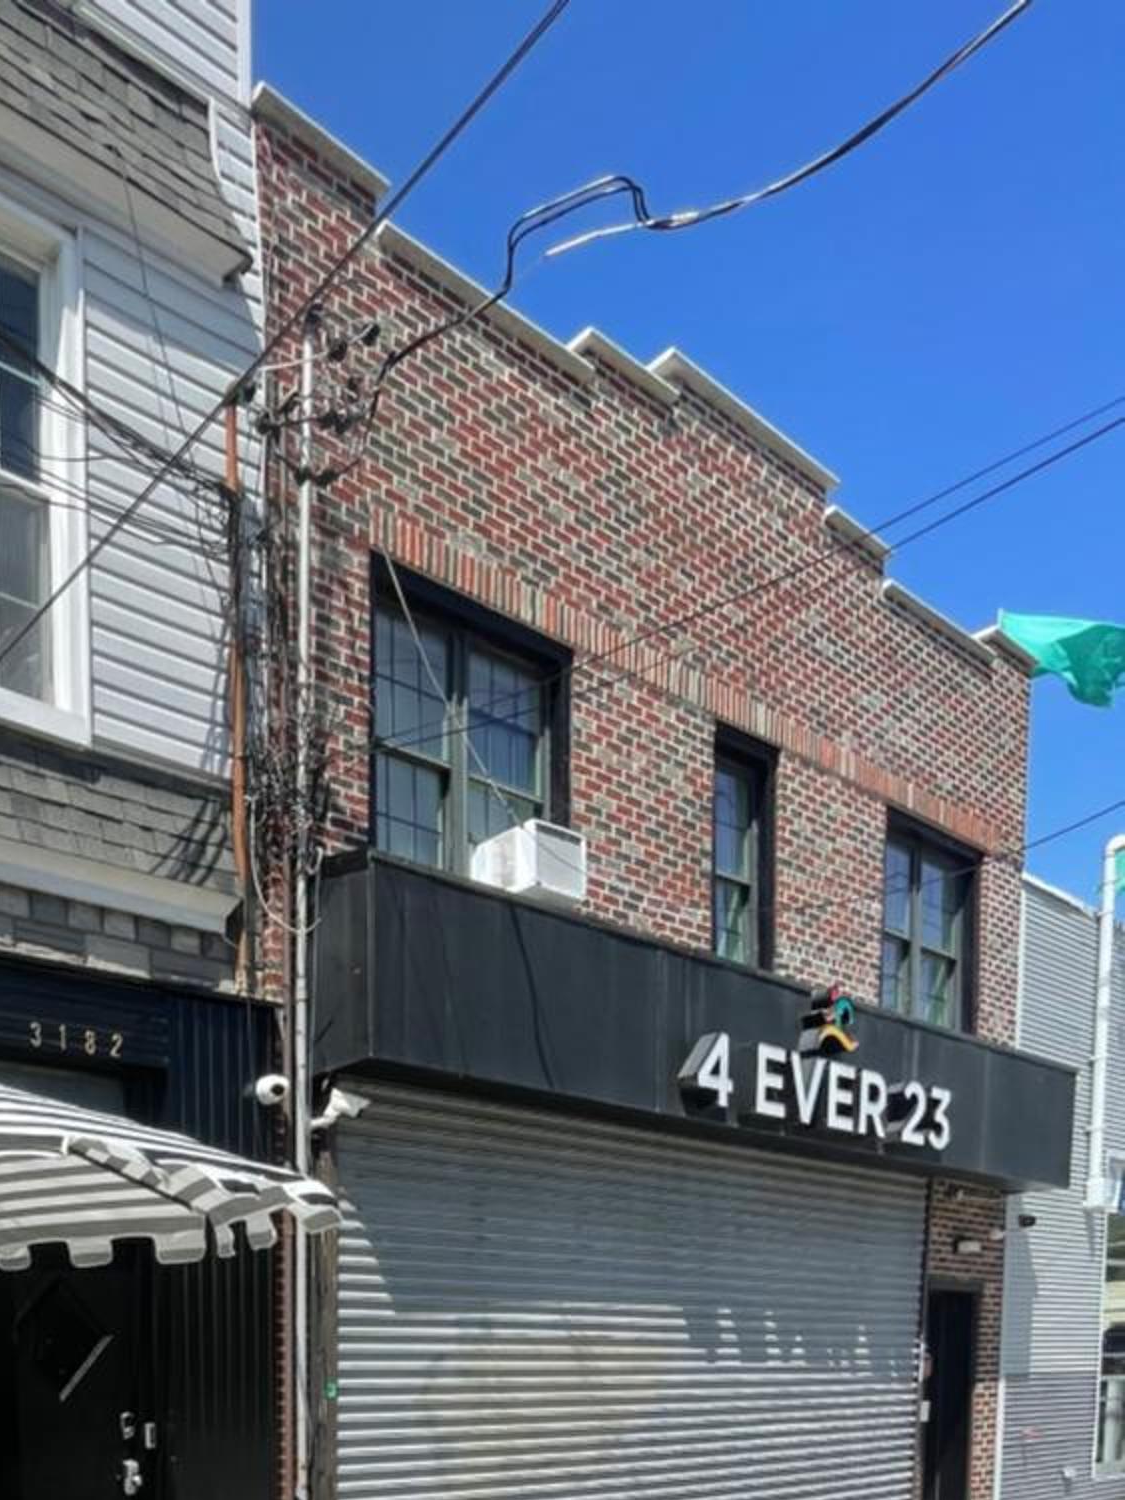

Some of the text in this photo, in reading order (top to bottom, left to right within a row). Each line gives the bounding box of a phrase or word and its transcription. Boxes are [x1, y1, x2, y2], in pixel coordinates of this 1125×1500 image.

[29, 1021, 124, 1058] 3182
[697, 1032, 952, 1151] 4 EVER 23
